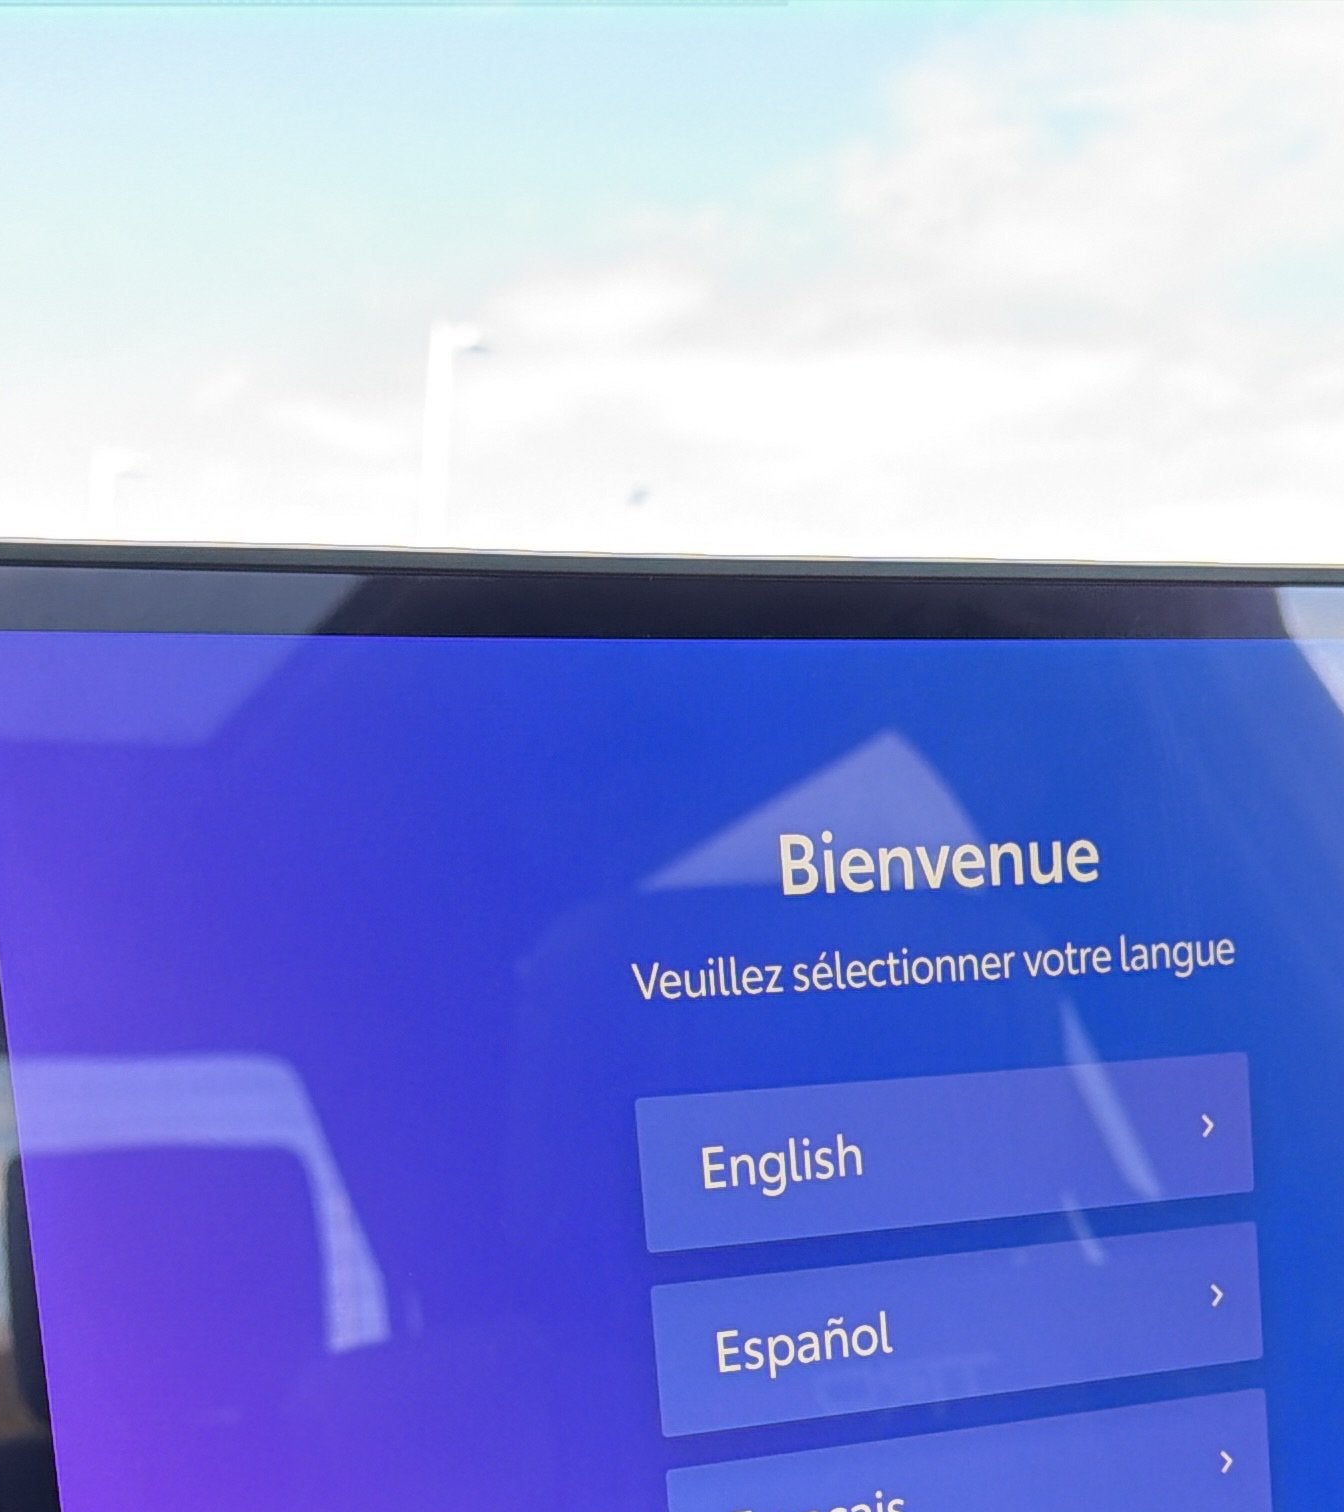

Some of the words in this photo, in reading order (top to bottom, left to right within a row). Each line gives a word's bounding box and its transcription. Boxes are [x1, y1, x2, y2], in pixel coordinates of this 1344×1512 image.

[779, 830, 1100, 896] Bienvenue
[632, 957, 784, 1000] Veuillez
[793, 948, 1016, 992] sélectionner
[1022, 941, 1112, 977] votre
[1120, 934, 1236, 979] langue
[701, 1134, 863, 1197] English
[716, 1311, 894, 1379] Español
